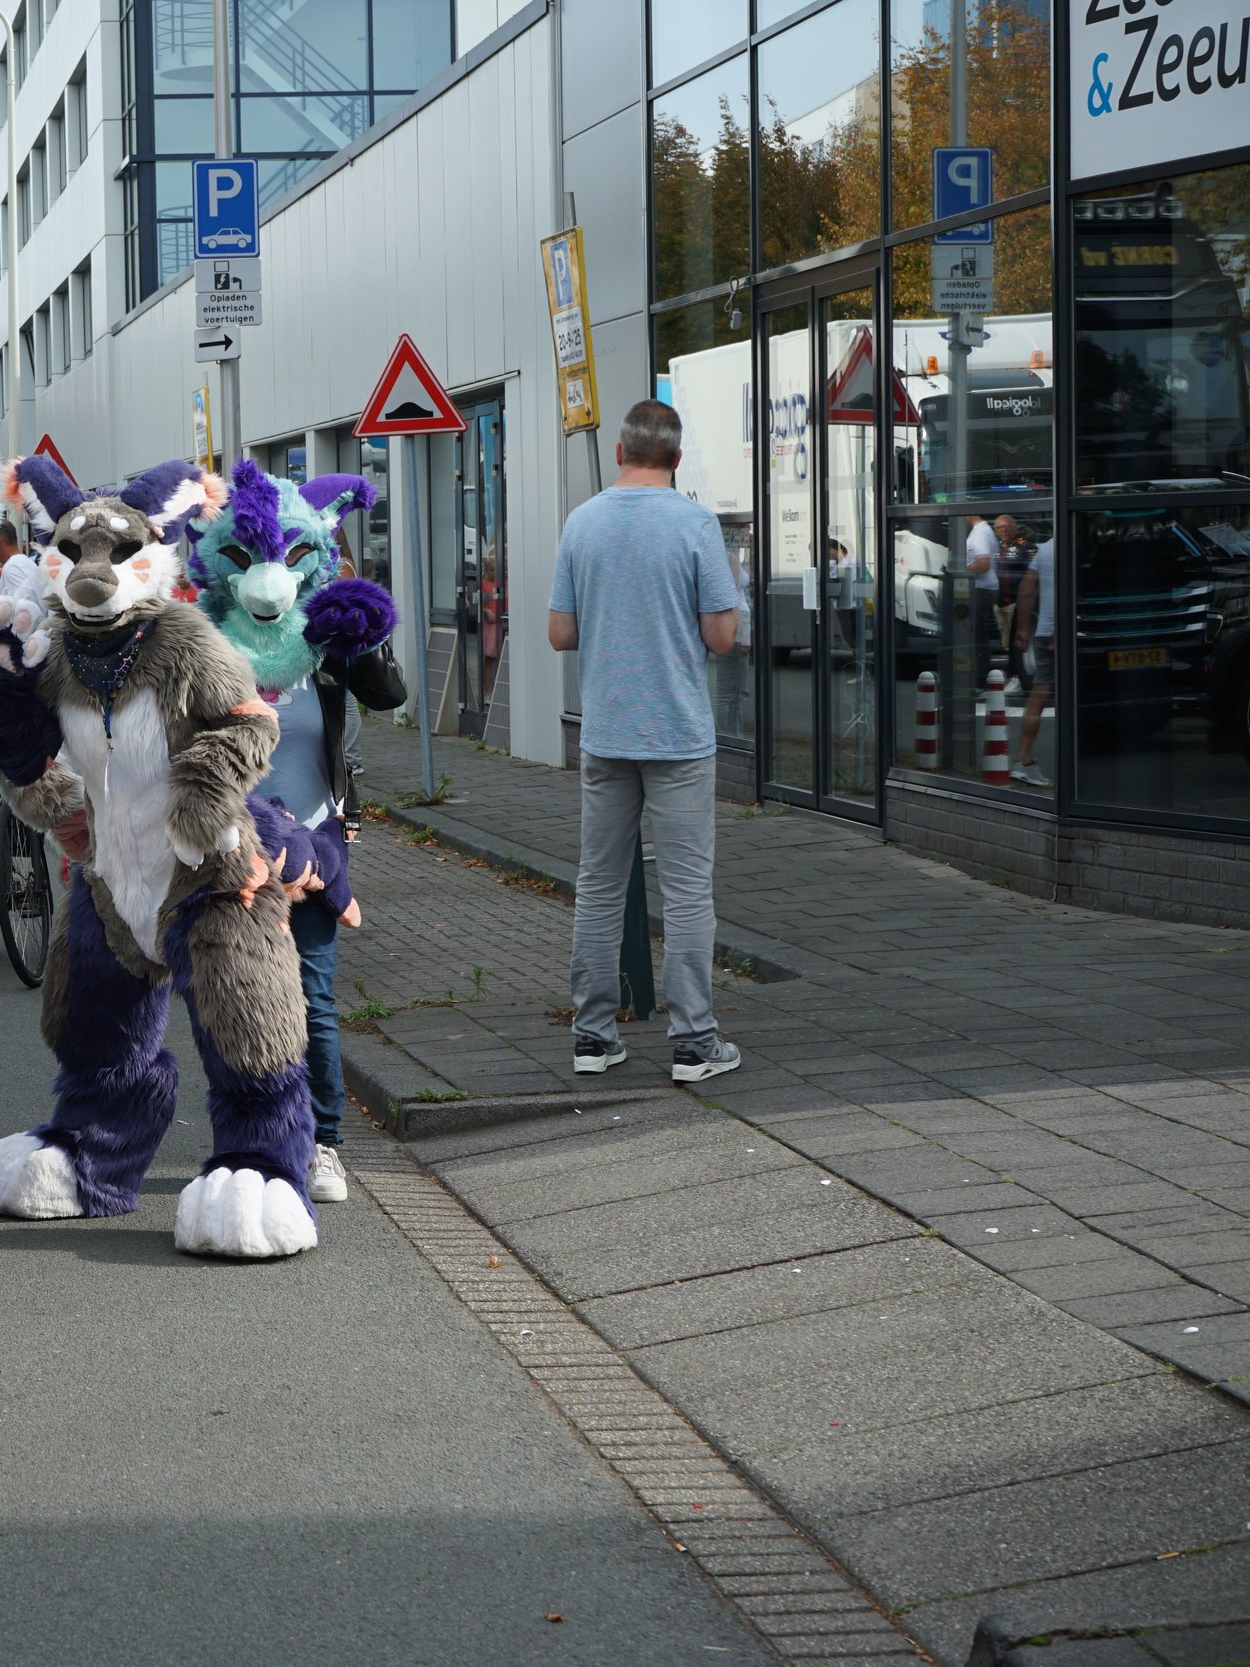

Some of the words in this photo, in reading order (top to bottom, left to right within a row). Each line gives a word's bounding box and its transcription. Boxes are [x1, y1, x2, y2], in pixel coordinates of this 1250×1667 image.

[1087, 52, 1113, 117] &
[1118, 15, 1250, 111] Zeeu
[208, 168, 242, 217] P
[554, 248, 566, 300] P
[203, 304, 255, 313] elektrische
[210, 293, 247, 303] Opladen
[204, 315, 254, 325] voertuigen
